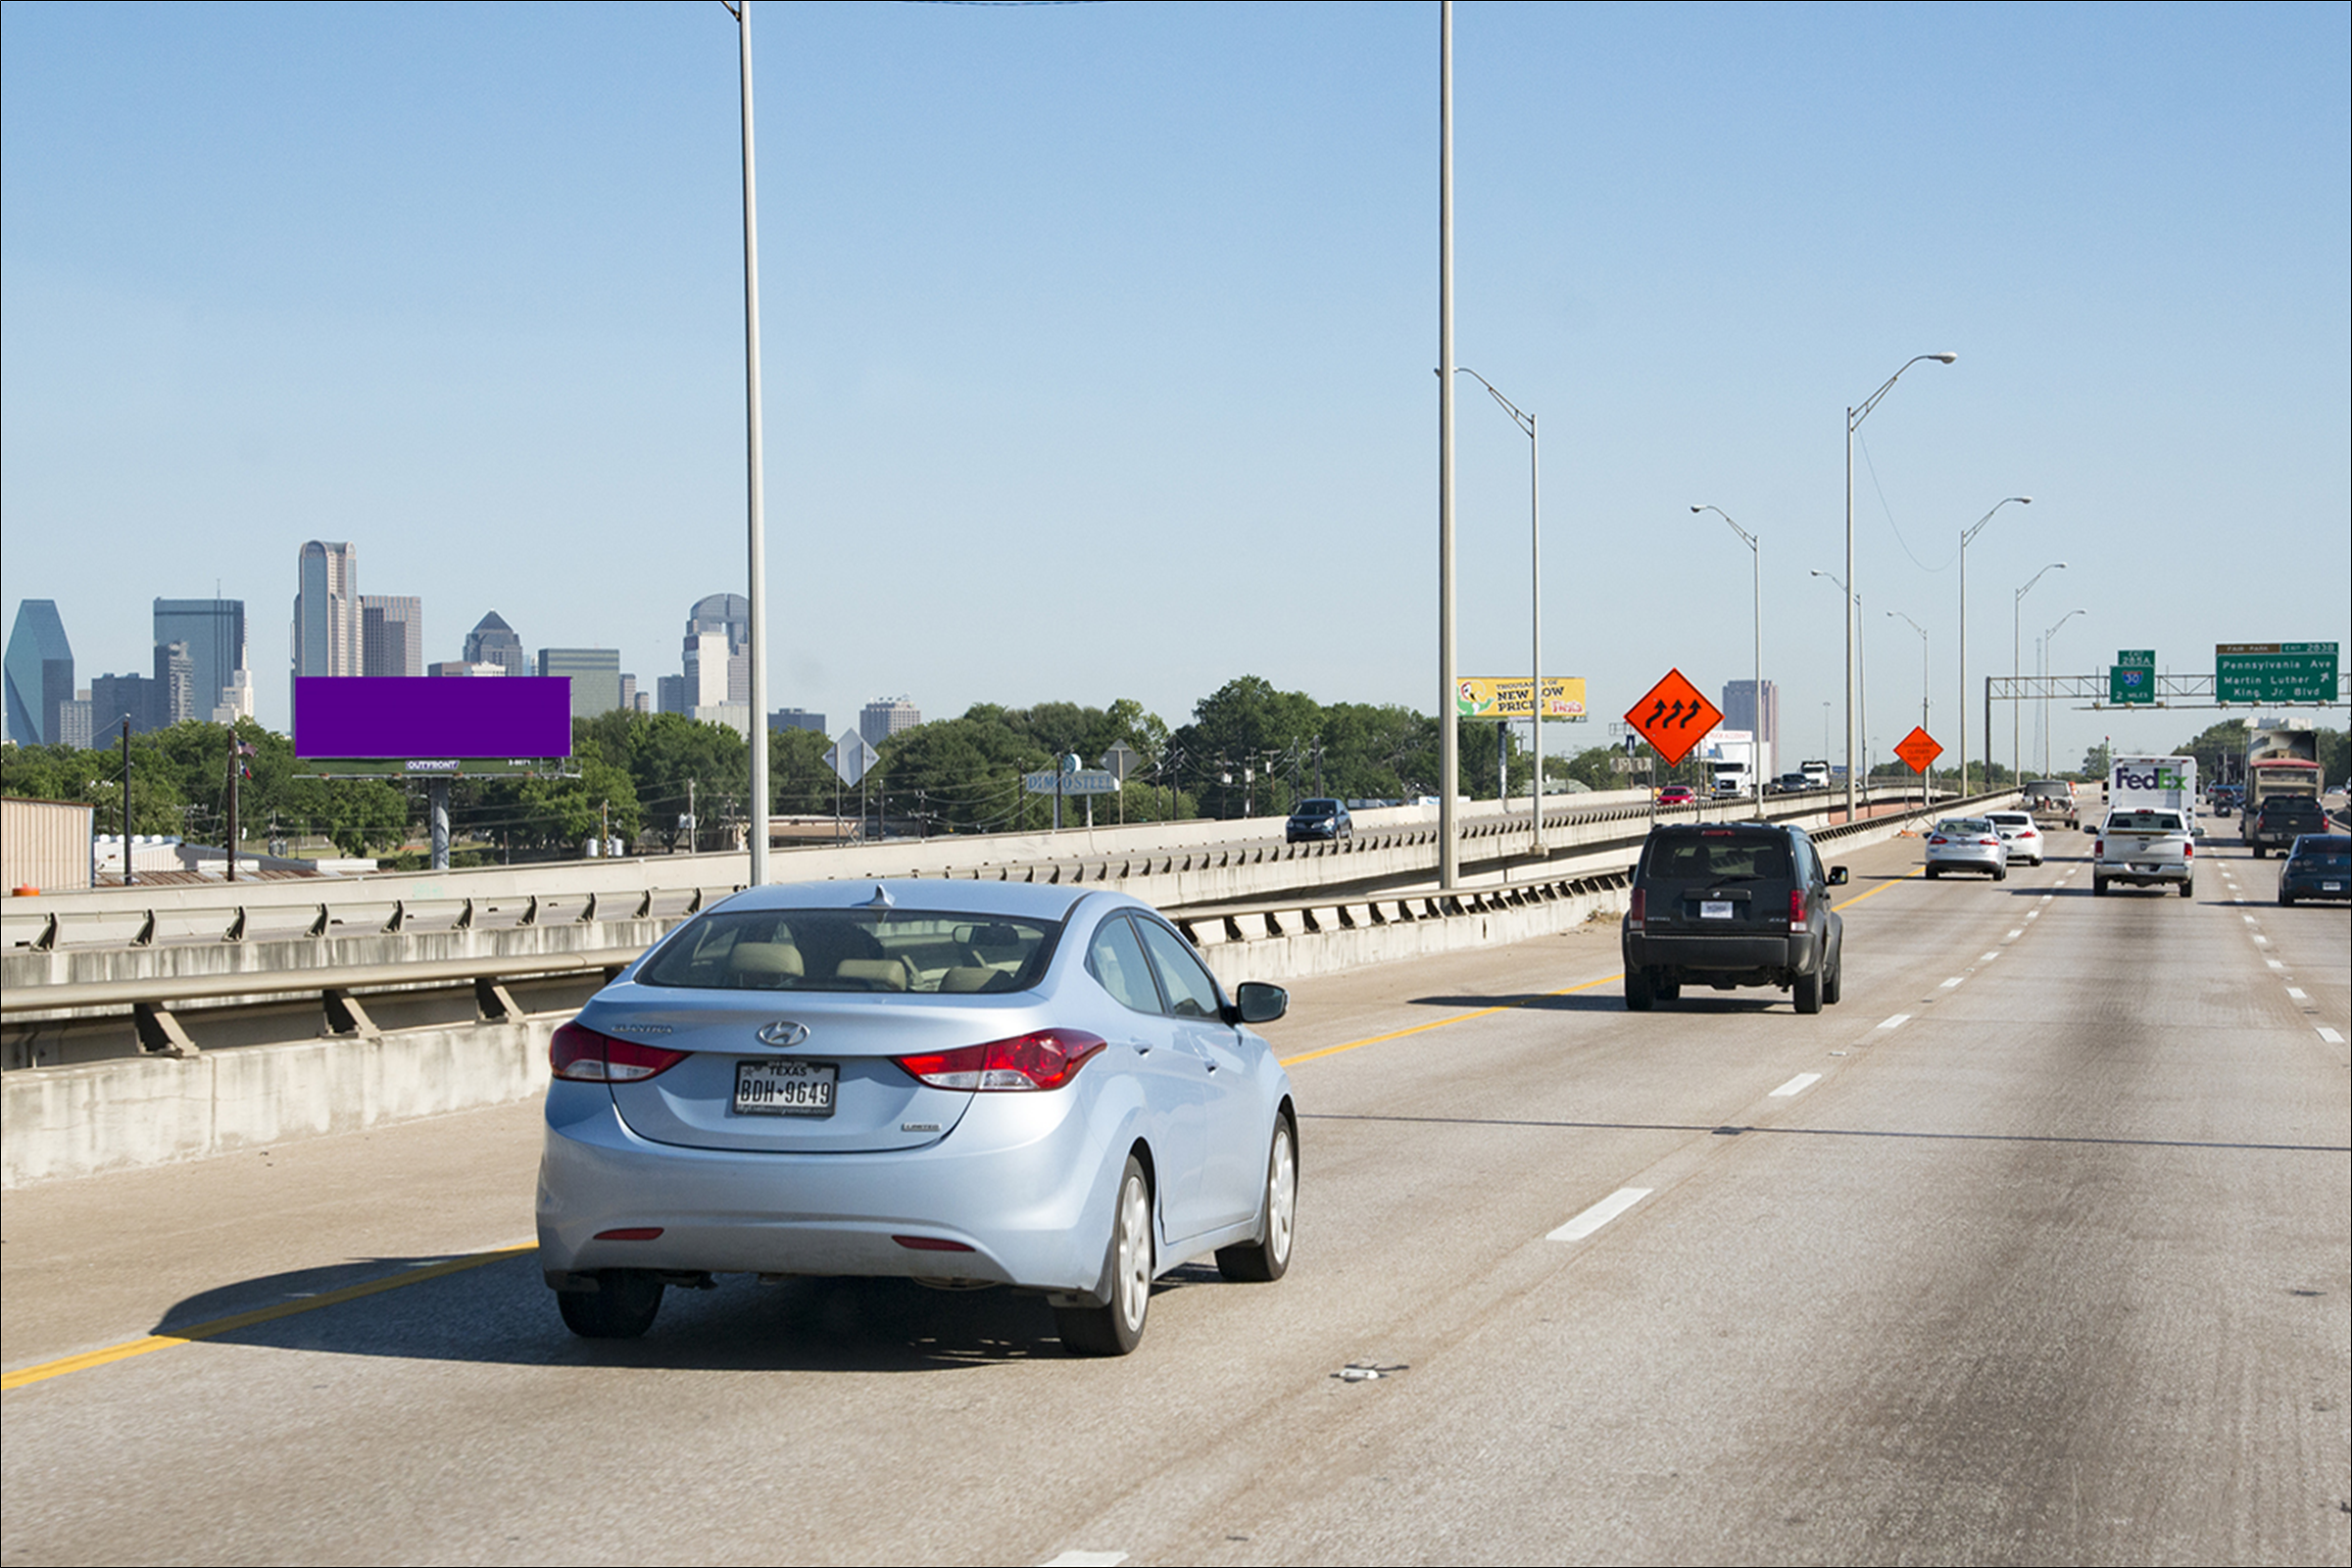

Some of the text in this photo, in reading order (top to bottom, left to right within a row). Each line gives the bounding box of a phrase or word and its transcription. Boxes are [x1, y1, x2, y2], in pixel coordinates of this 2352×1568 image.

[2222, 660, 2331, 670] Pennsylvania Ave
[2224, 675, 2310, 685] Martin Luther
[1496, 687, 1565, 701] NEW OW
[2293, 688, 2321, 697] Blvd
[1497, 700, 1545, 712] PRICS
[408, 760, 456, 769] OUTFRONT
[1027, 775, 1114, 790] DIMO STEEL
[2116, 768, 2188, 791] FedEx
[768, 1066, 808, 1076] TEXAS
